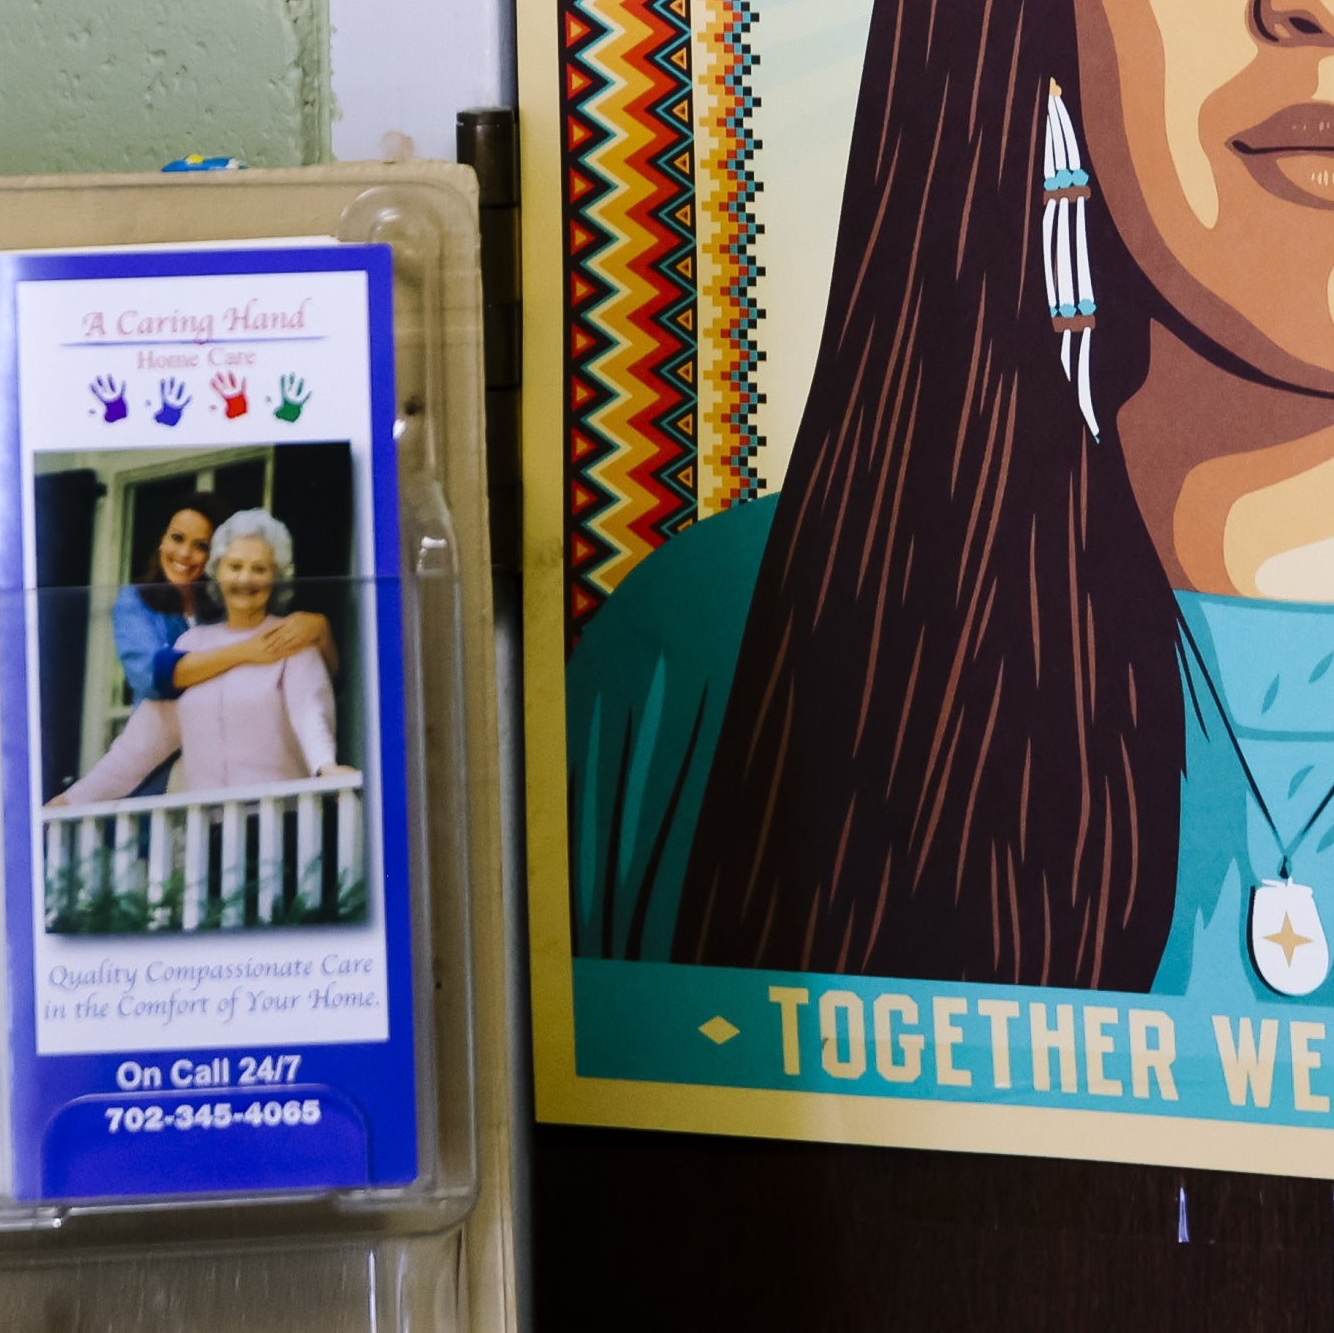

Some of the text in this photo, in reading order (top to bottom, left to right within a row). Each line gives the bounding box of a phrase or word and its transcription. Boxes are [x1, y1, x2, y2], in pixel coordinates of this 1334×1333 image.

[82, 297, 312, 345] A Caring Hand
[137, 347, 256, 370] Home Care
[47, 953, 374, 993] Quality Compassionate Care
[44, 981, 381, 1026] in the Comfort of Your Home.
[767, 984, 1179, 1101] TOGETHER
[1211, 1013, 1331, 1113] WE
[116, 1054, 303, 1090] On Call 24/7
[104, 1098, 323, 1134] 702-345-4065
